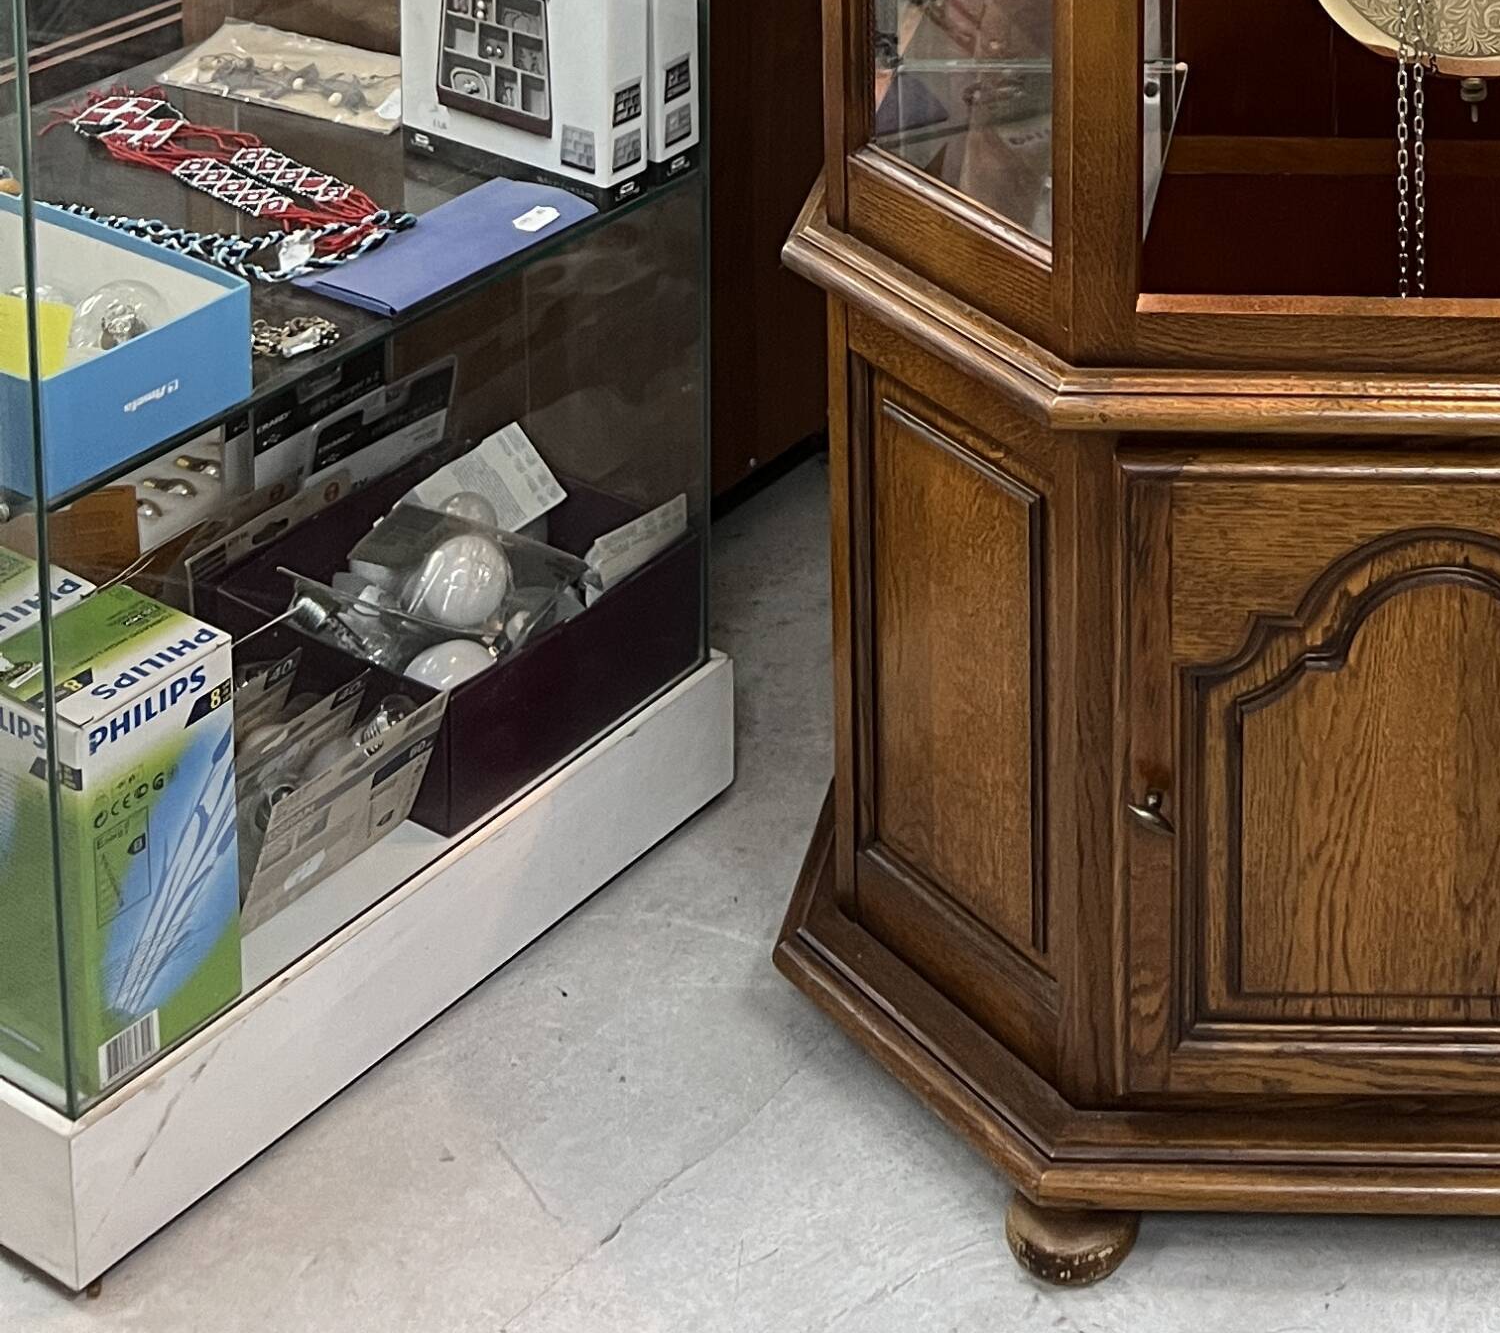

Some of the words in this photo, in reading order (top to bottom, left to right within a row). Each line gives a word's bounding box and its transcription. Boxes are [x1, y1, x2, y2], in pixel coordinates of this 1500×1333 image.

[63, 678, 83, 691] 8
[91, 627, 219, 700] PHILIPS
[88, 664, 208, 758] PHILIPS
[209, 688, 222, 710] 8
[0, 706, 47, 751] LIPS
